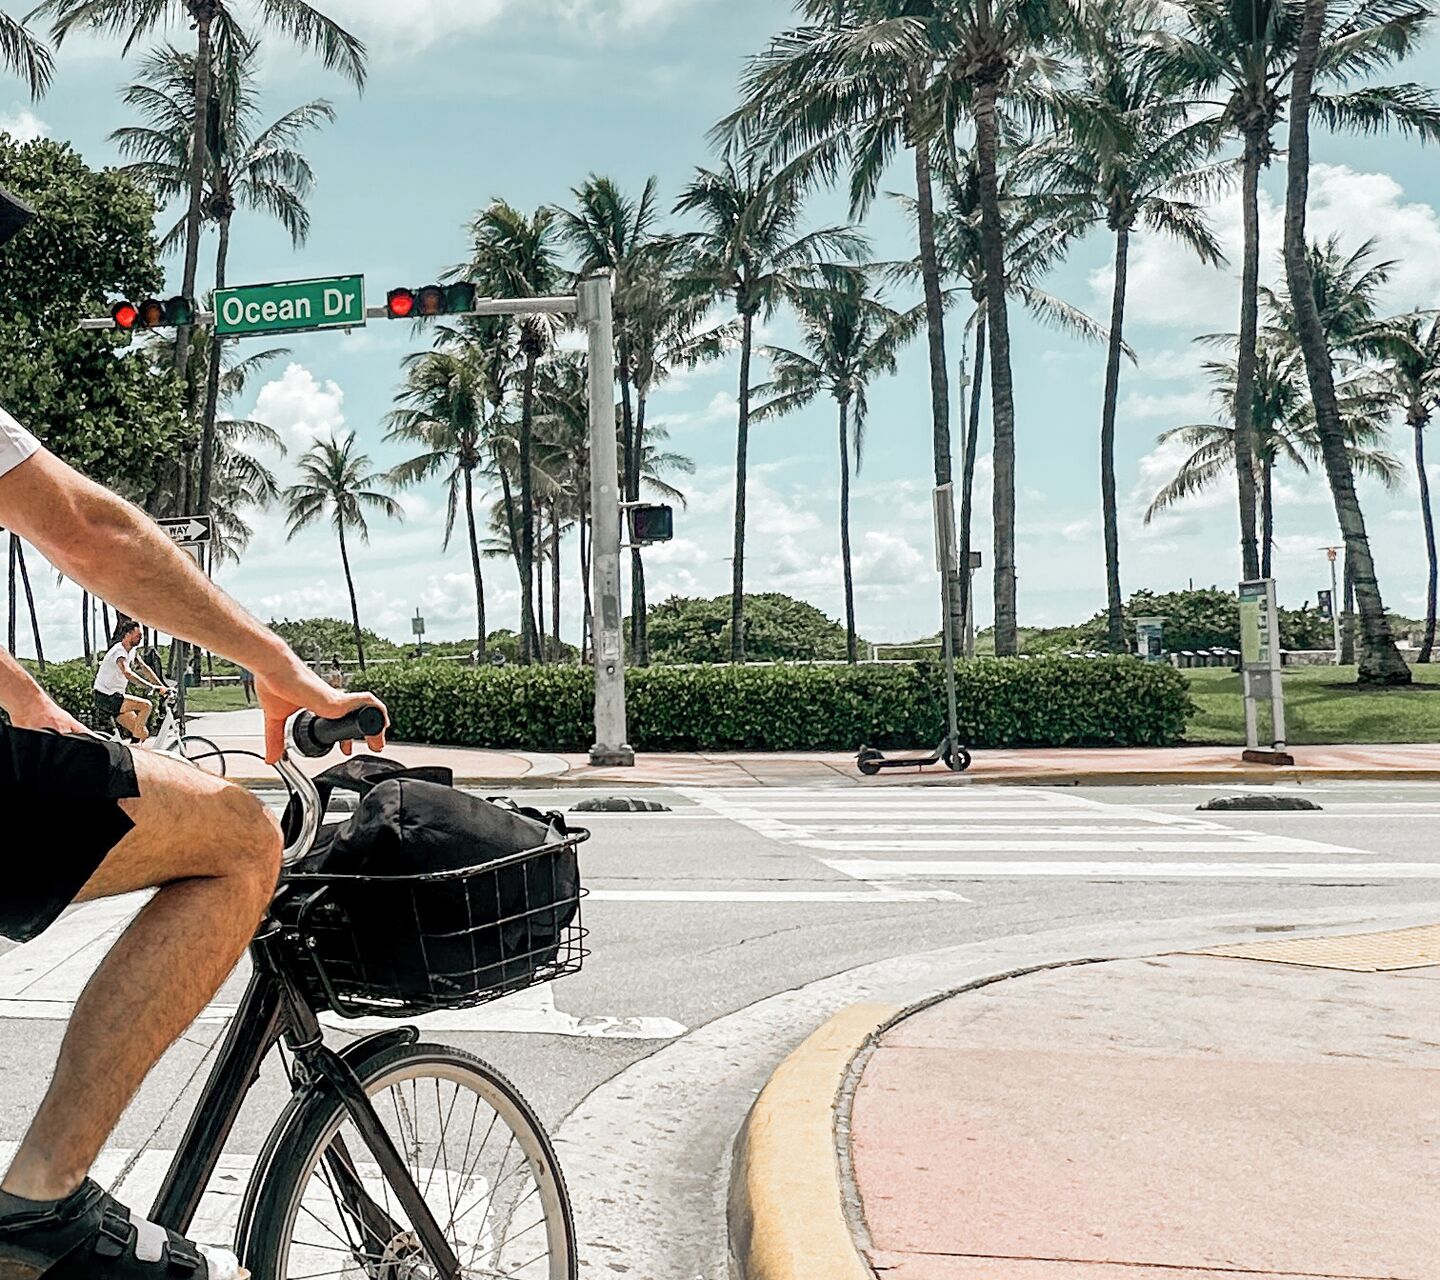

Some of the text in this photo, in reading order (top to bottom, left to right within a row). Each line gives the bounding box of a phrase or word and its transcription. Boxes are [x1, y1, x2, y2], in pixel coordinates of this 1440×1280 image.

[222, 288, 355, 325] Ocean Dr
[169, 525, 189, 536] WAY
